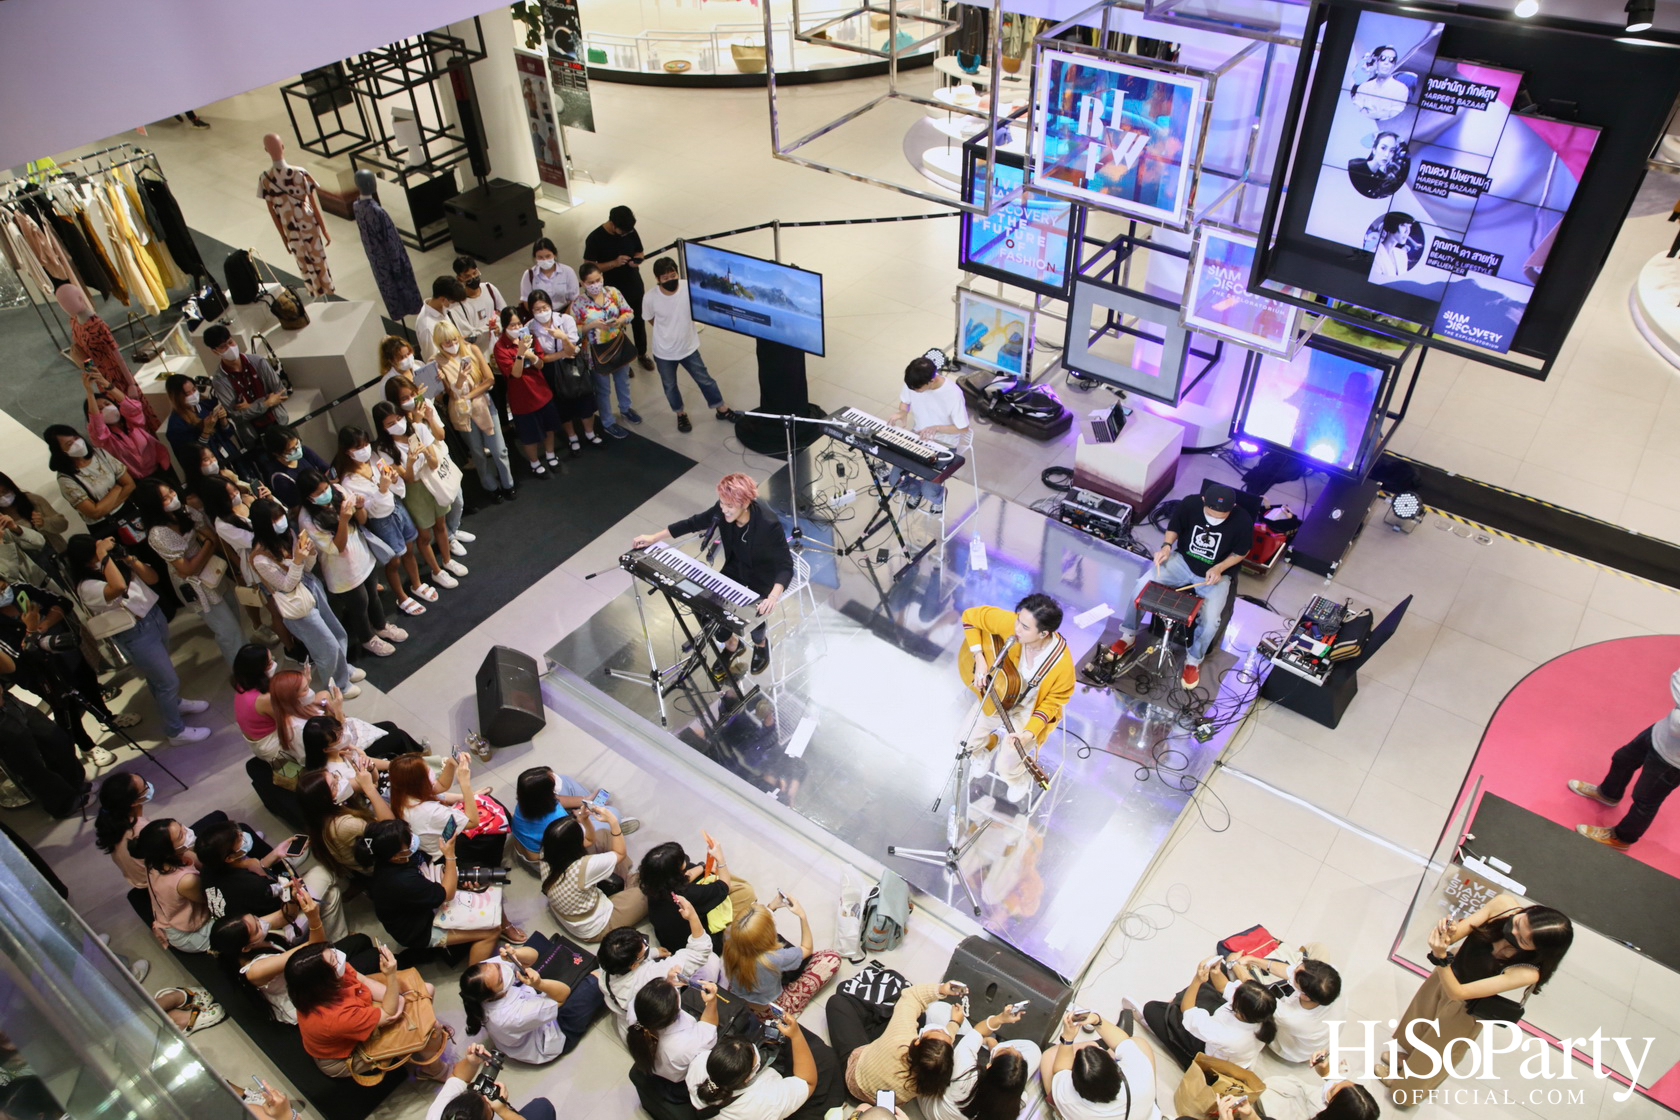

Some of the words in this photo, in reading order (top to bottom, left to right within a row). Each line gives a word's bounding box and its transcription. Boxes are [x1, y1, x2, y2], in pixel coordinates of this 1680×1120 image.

[1457, 98, 1486, 110] BAZAAR
[1415, 183, 1447, 196] THAILAND
[1417, 176, 1448, 188] HARPER'S
[1449, 182, 1477, 195] BAZAAR
[998, 213, 1028, 230] THE
[983, 220, 1046, 247] FUTURE
[1005, 239, 1026, 251] OF
[1000, 247, 1056, 273] FASHION
[1430, 251, 1456, 262] BEAUTY
[1460, 262, 1493, 275] LIFESTYLE
[1207, 264, 1242, 282] SIAM
[1212, 290, 1225, 298] THE
[1227, 293, 1285, 315] EXPLORATORIUM
[1443, 310, 1470, 323] SIAM
[1445, 320, 1503, 343] DISCOVERY
[1455, 333, 1500, 349] EXPLORATORIUM
[1449, 880, 1487, 902] SIAM
[1453, 873, 1497, 898] LIVE
